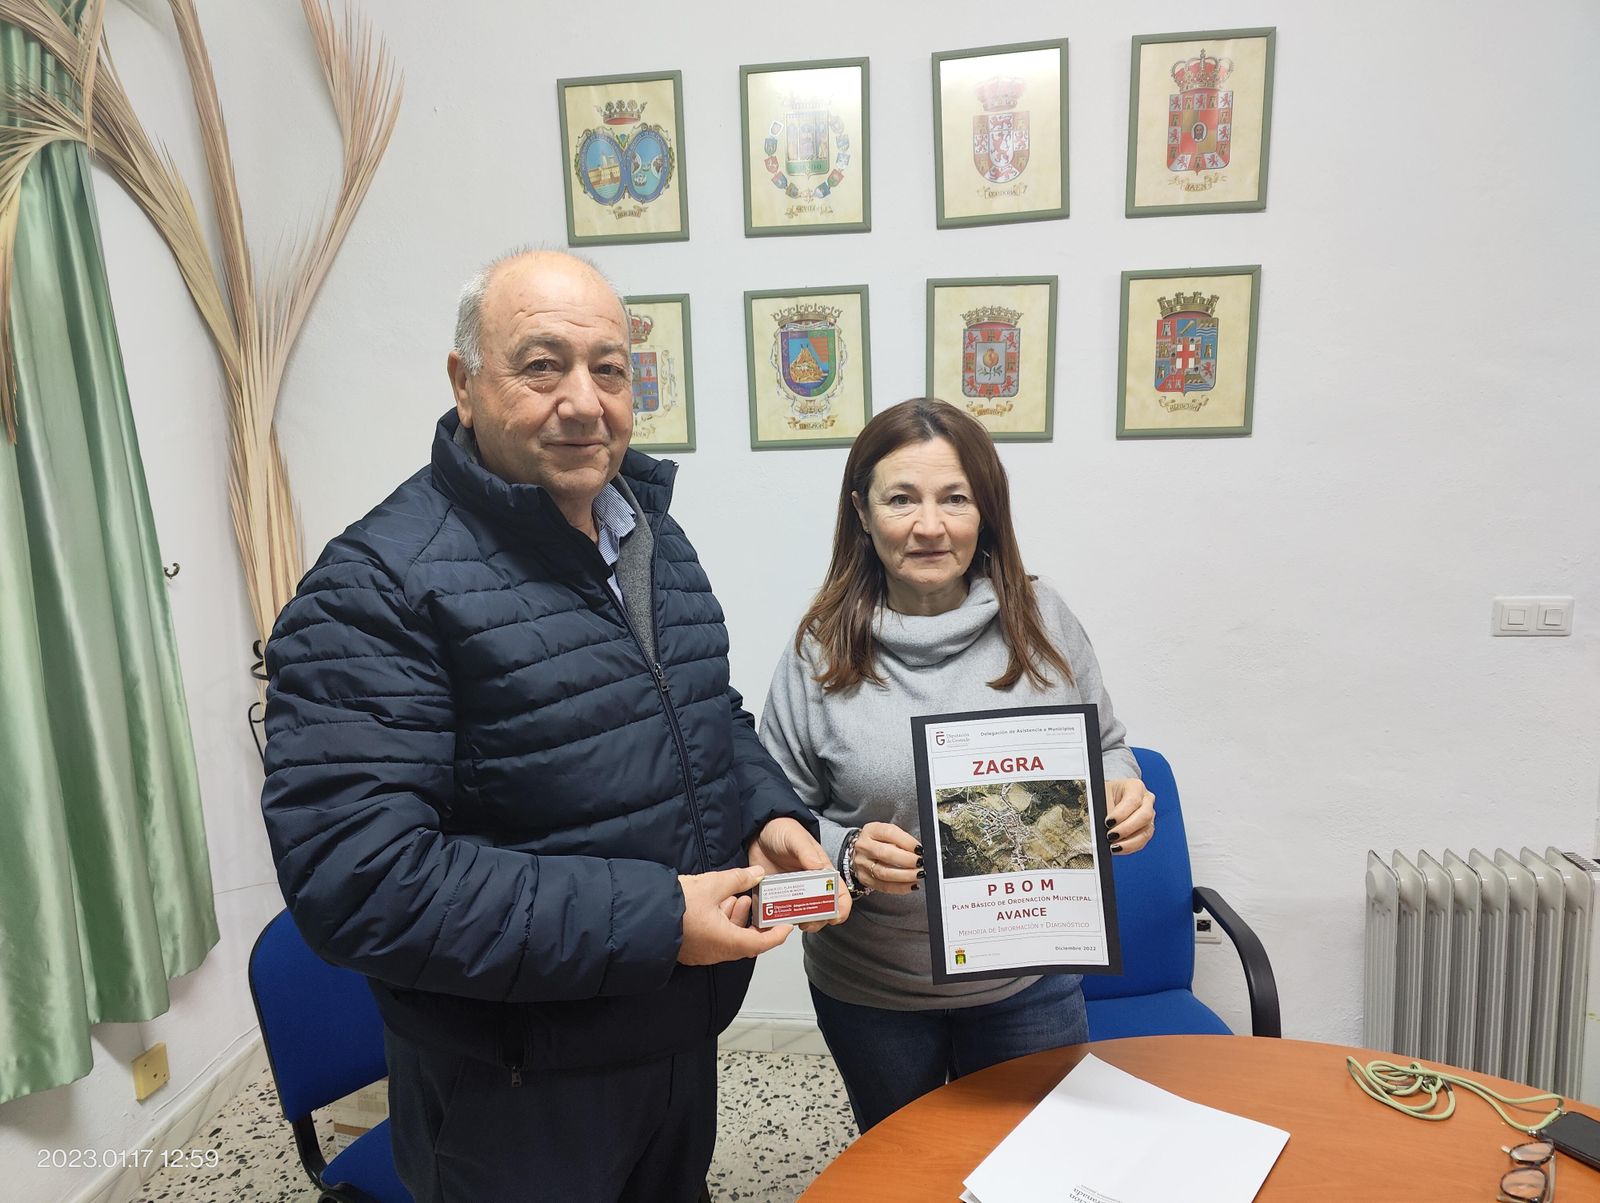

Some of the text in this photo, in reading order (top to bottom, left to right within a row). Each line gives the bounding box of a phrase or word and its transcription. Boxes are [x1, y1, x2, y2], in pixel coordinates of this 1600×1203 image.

[972, 756, 1045, 776] ZAGRA
[996, 907, 1047, 921] AVANCE
[958, 928, 987, 937] MEMORIA
[1045, 921, 1090, 929] DIAGNÓSTICO
